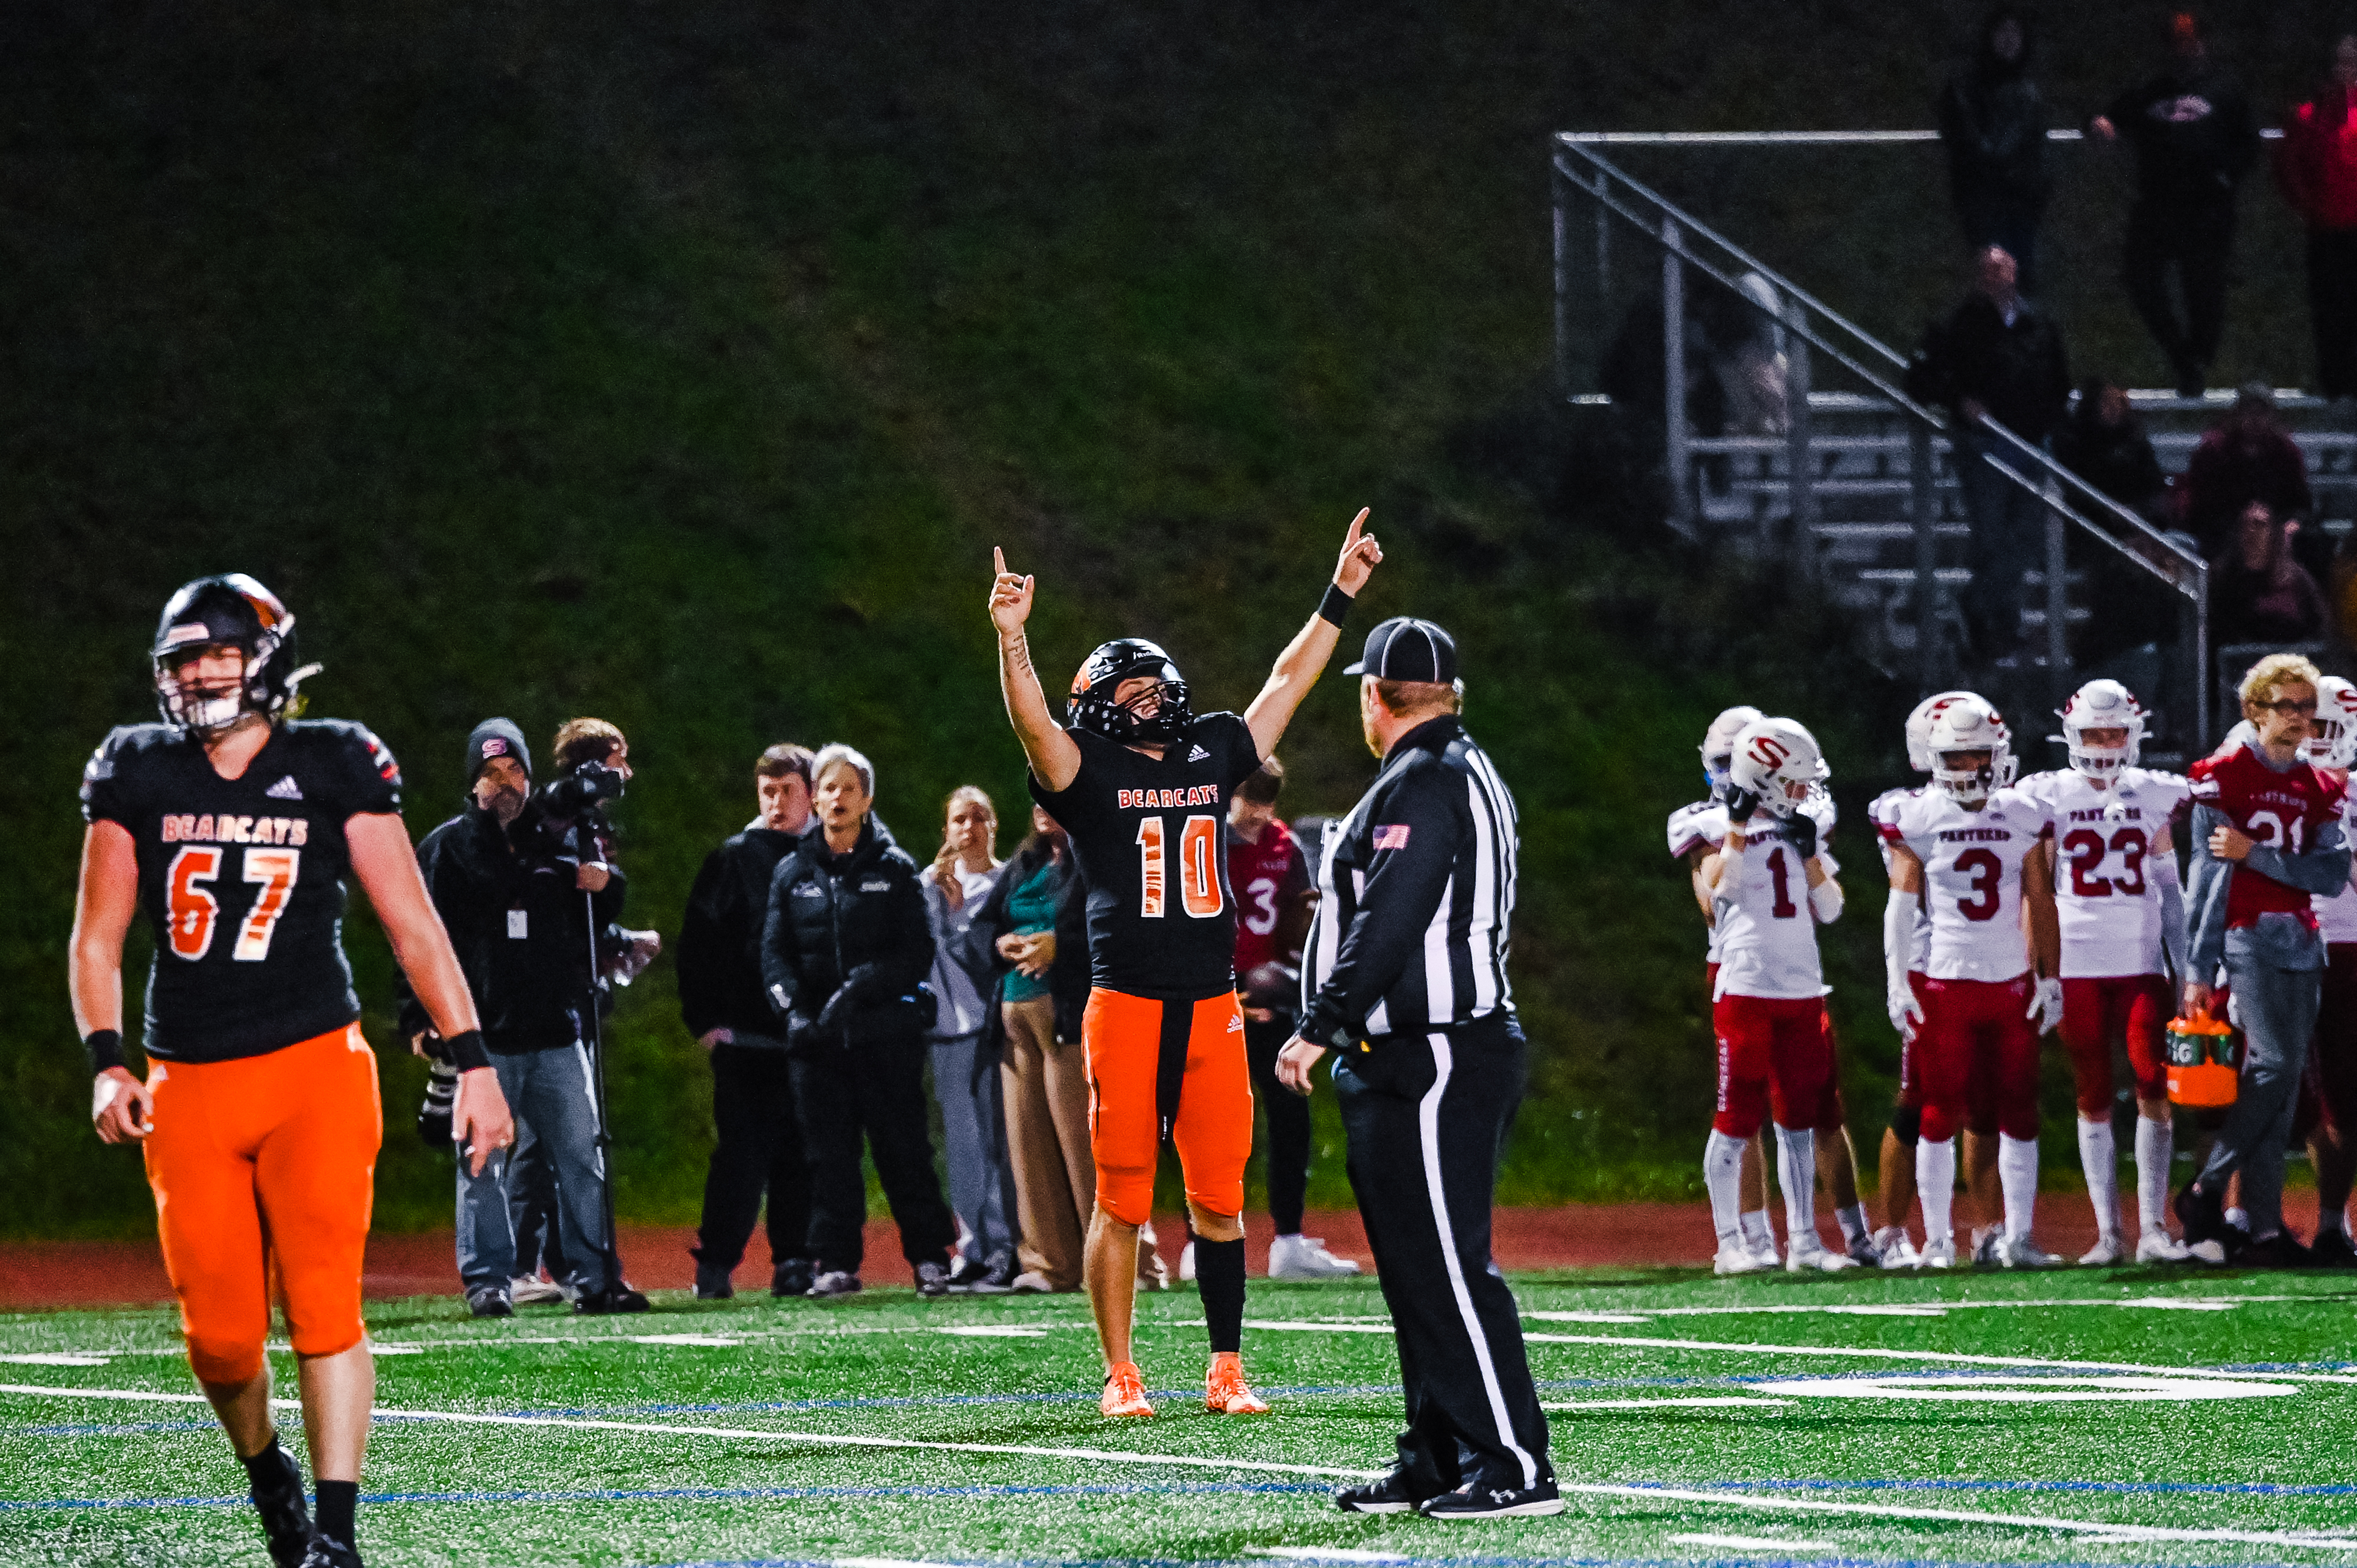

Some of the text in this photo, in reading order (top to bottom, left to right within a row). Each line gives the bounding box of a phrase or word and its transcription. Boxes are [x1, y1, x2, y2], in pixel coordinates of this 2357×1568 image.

[1187, 752, 1210, 762] adidas
[1747, 736, 1790, 769] S
[1118, 784, 1219, 809] BEARCATS
[162, 813, 309, 846] BEARCATS
[1135, 815, 1224, 918] 10
[1766, 846, 1797, 919] 1
[1953, 847, 2003, 922] 3
[2063, 828, 2148, 897] 23
[166, 844, 301, 962] 67
[1245, 877, 1278, 935] 3
